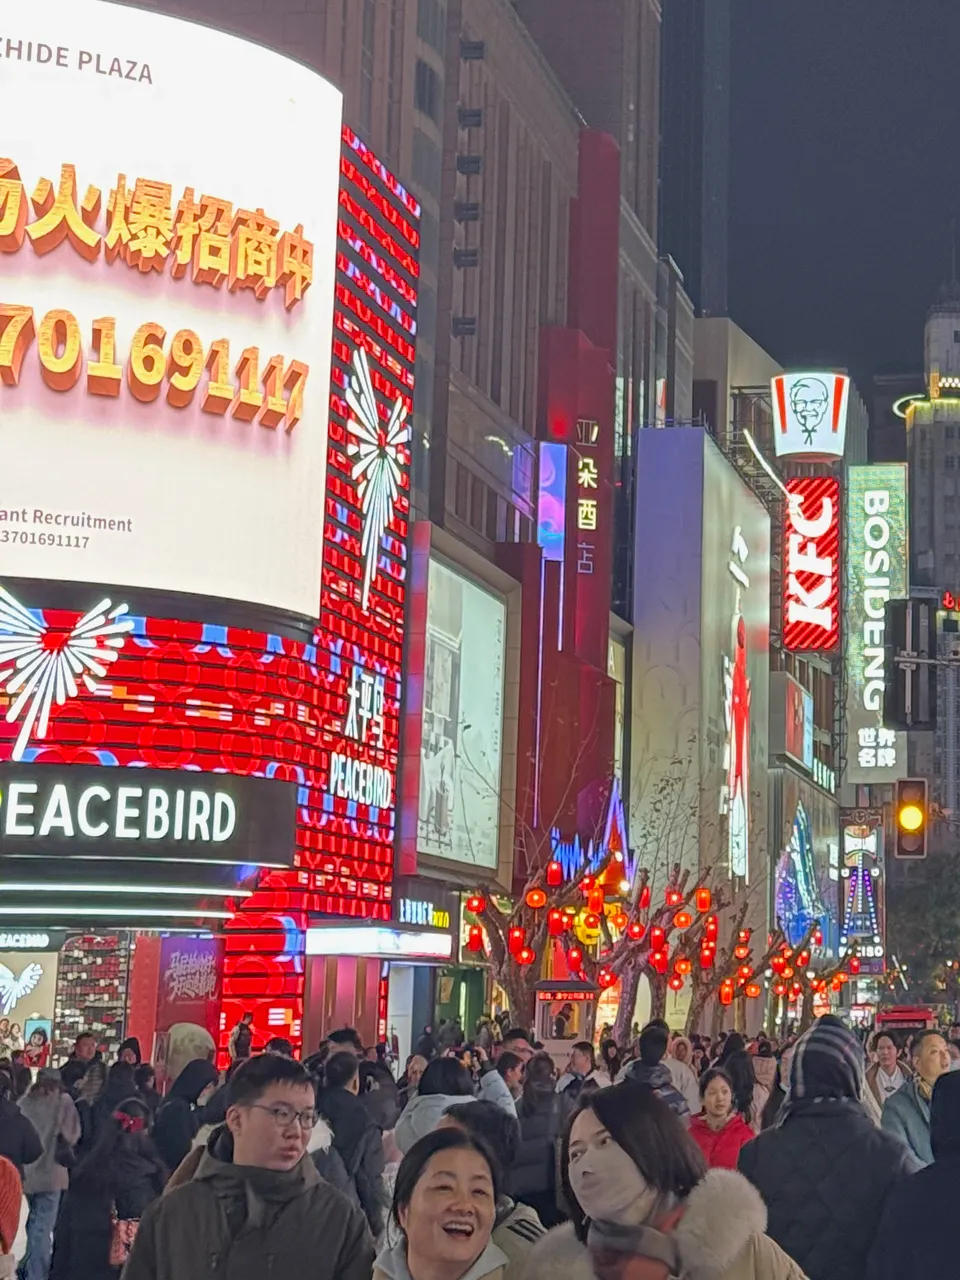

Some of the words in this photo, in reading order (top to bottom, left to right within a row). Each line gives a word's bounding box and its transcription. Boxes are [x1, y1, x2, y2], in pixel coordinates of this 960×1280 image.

[0, 37, 69, 68] HIDE
[78, 50, 153, 85] PLAZA
[0, 530, 90, 549] 3701691117
[33, 509, 133, 533] Recruitment
[788, 493, 833, 631] KFC
[863, 489, 890, 711] BOSIDENG
[330, 751, 392, 809] PEACEBIRD
[0, 782, 237, 842] EACEBIRD
